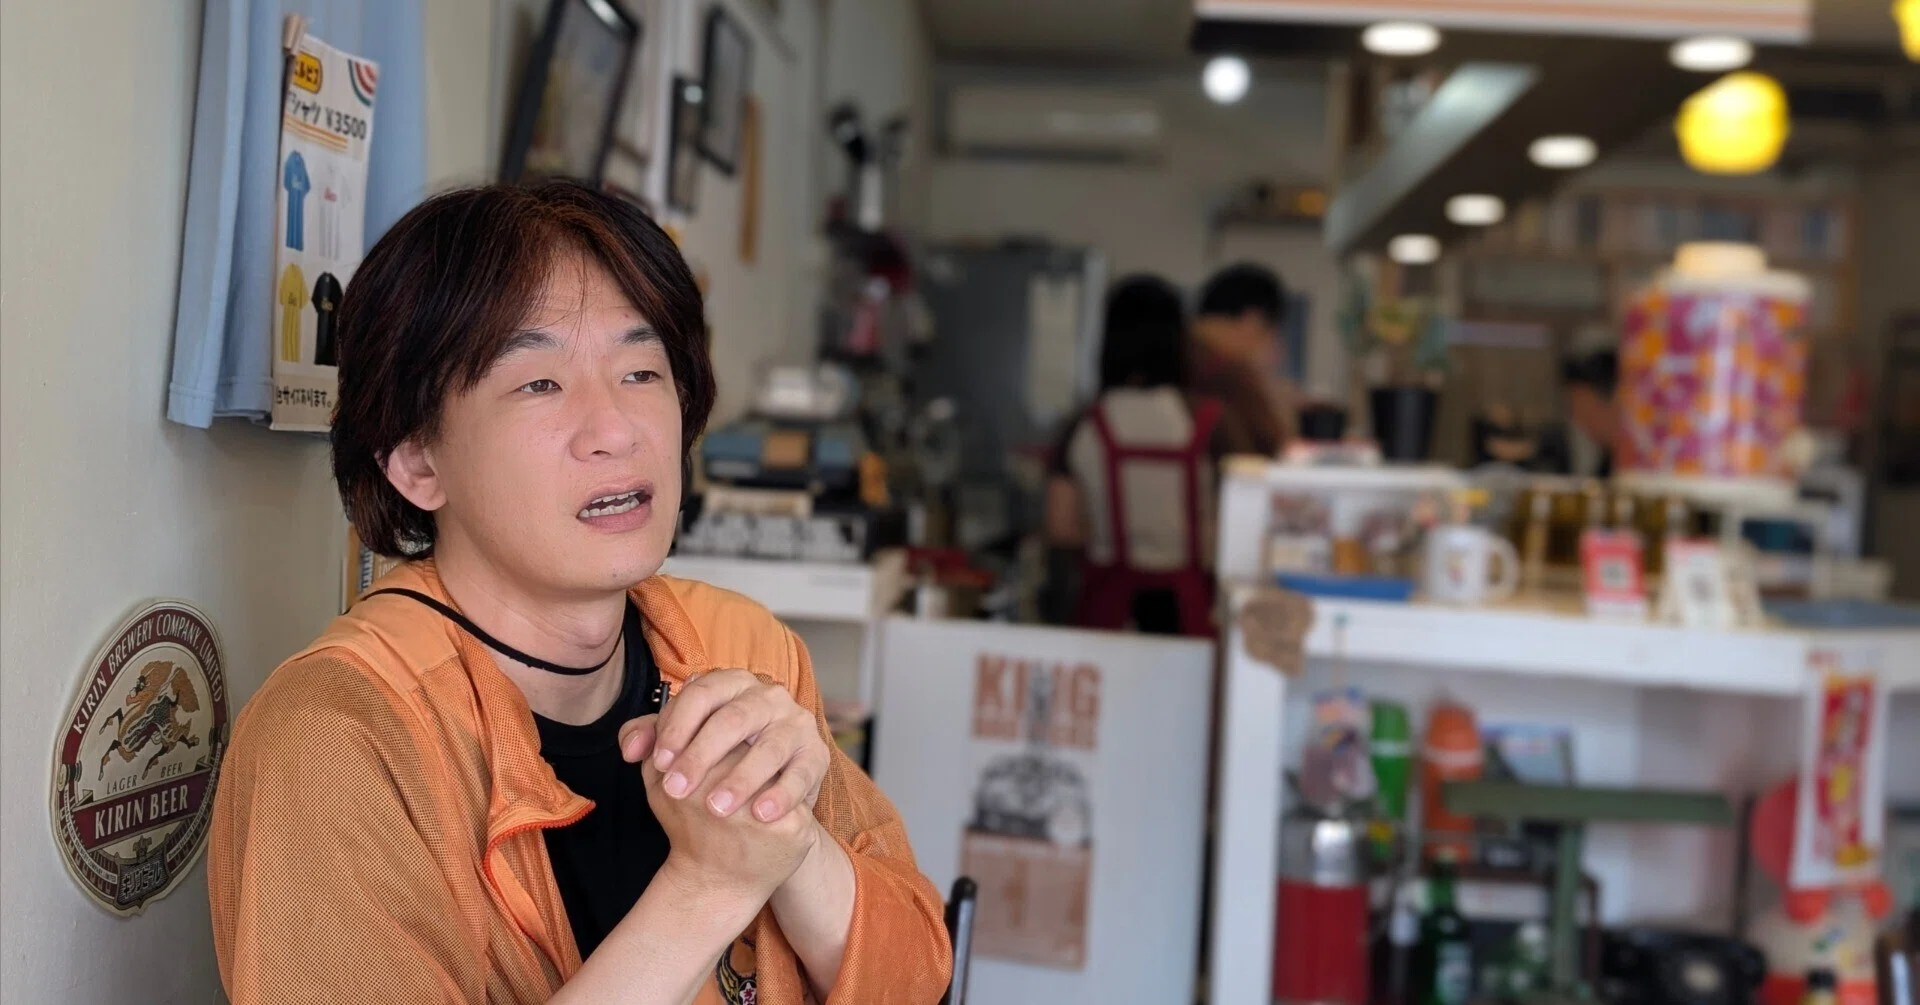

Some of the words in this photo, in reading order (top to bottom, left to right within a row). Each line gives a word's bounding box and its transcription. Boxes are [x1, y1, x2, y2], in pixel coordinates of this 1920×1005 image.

[325, 106, 367, 141] ¥3500
[73, 671, 107, 734] KIRIN
[108, 618, 153, 675] BREWERY
[156, 614, 202, 649] COMPANY,
[200, 637, 223, 702] LIMITED
[107, 774, 138, 795] LAGER
[161, 762, 183, 778] BEER
[95, 797, 145, 839] KIRIN
[150, 784, 189, 821] BEER
